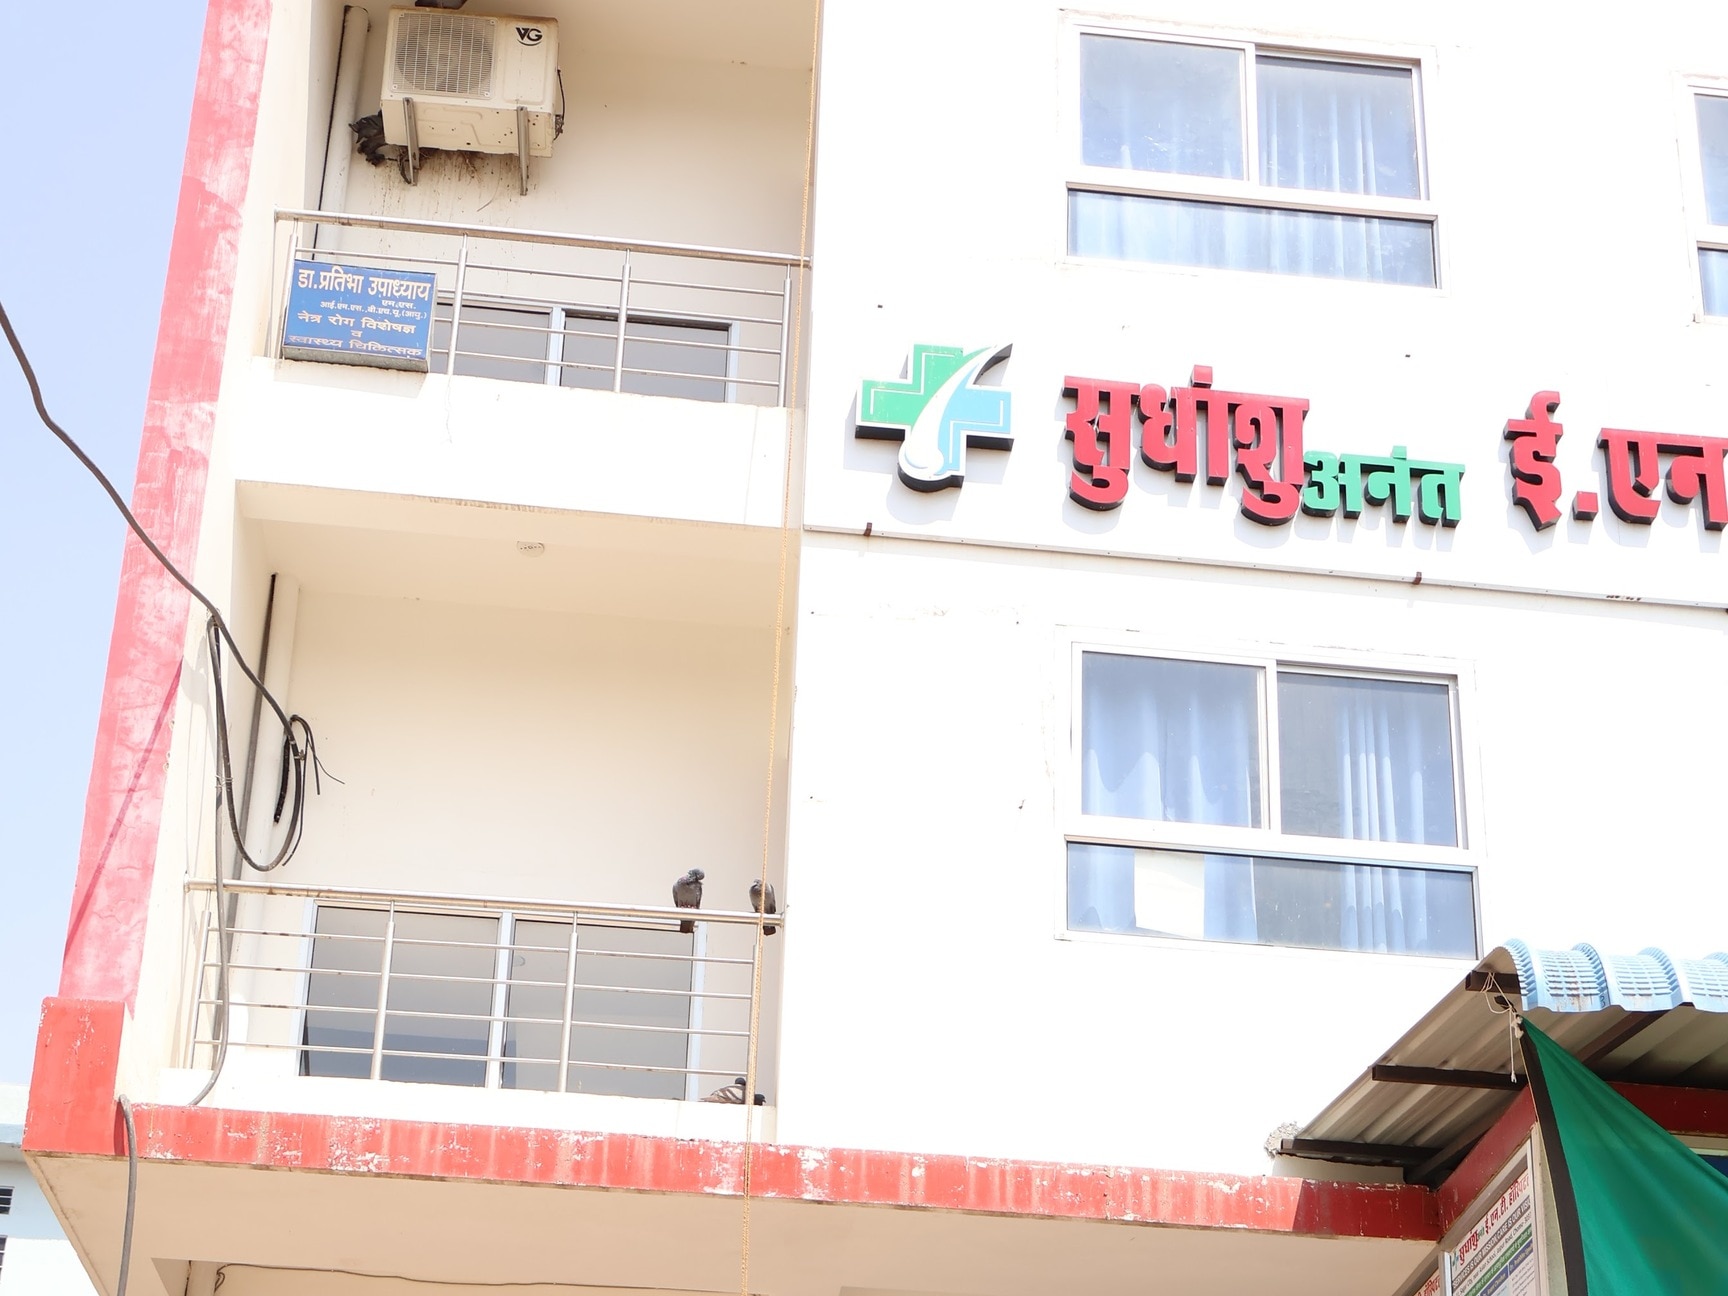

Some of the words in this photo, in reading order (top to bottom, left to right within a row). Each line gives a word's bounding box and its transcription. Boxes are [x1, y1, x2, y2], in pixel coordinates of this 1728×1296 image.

[515, 27, 543, 42] VG
[368, 276, 431, 301] उपाध्याय
[297, 311, 322, 324] नेत्र
[328, 314, 355, 326] रोग
[1060, 364, 1310, 526] सुधांशु
[1303, 445, 1466, 528] अनंत
